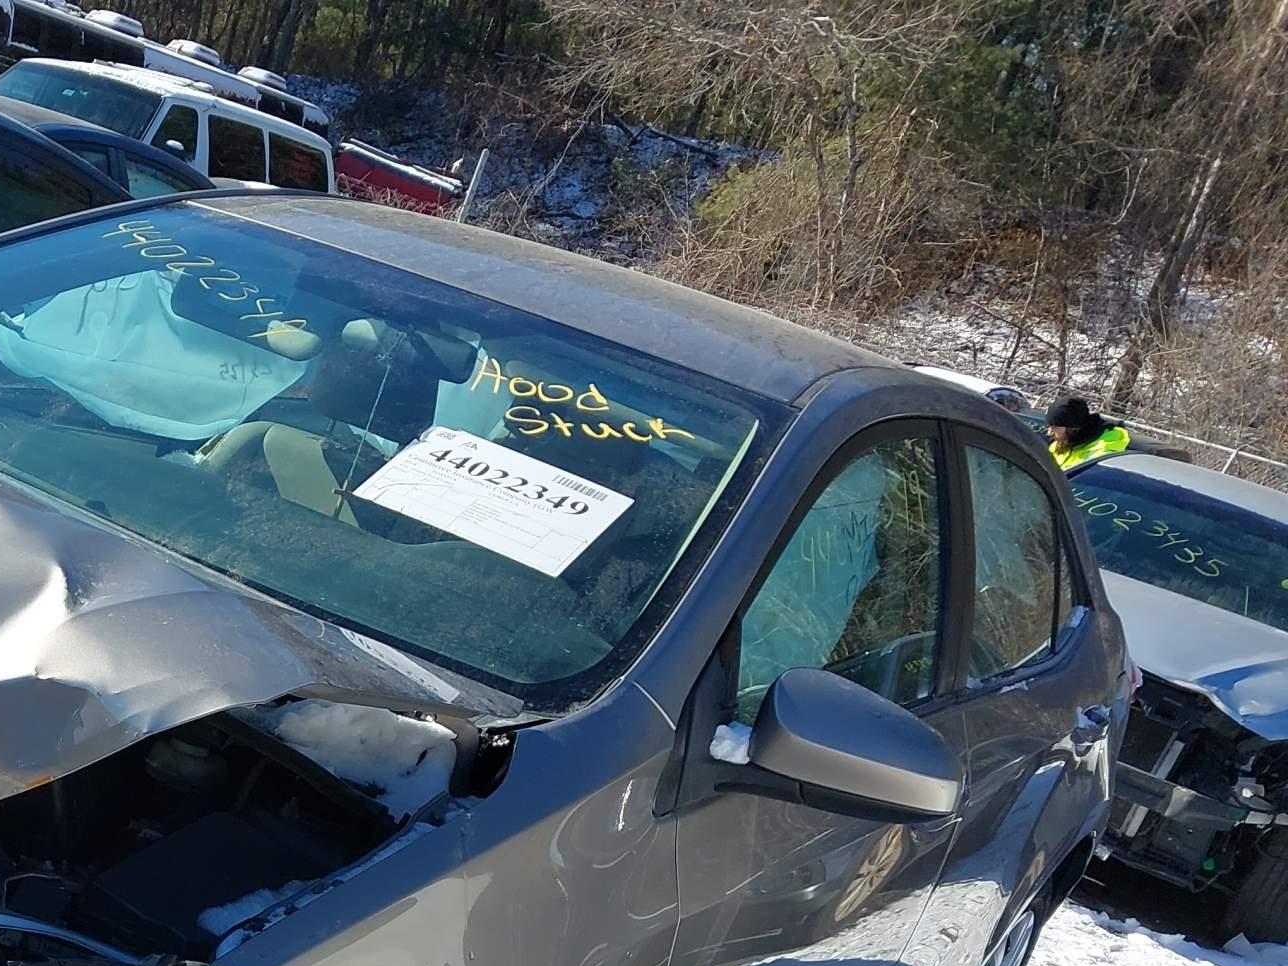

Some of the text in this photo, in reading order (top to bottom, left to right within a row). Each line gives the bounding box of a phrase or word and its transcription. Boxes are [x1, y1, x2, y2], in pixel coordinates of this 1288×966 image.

[471, 355, 610, 411] Hood
[505, 406, 695, 442] Stuck
[428, 449, 589, 515] 44022349
